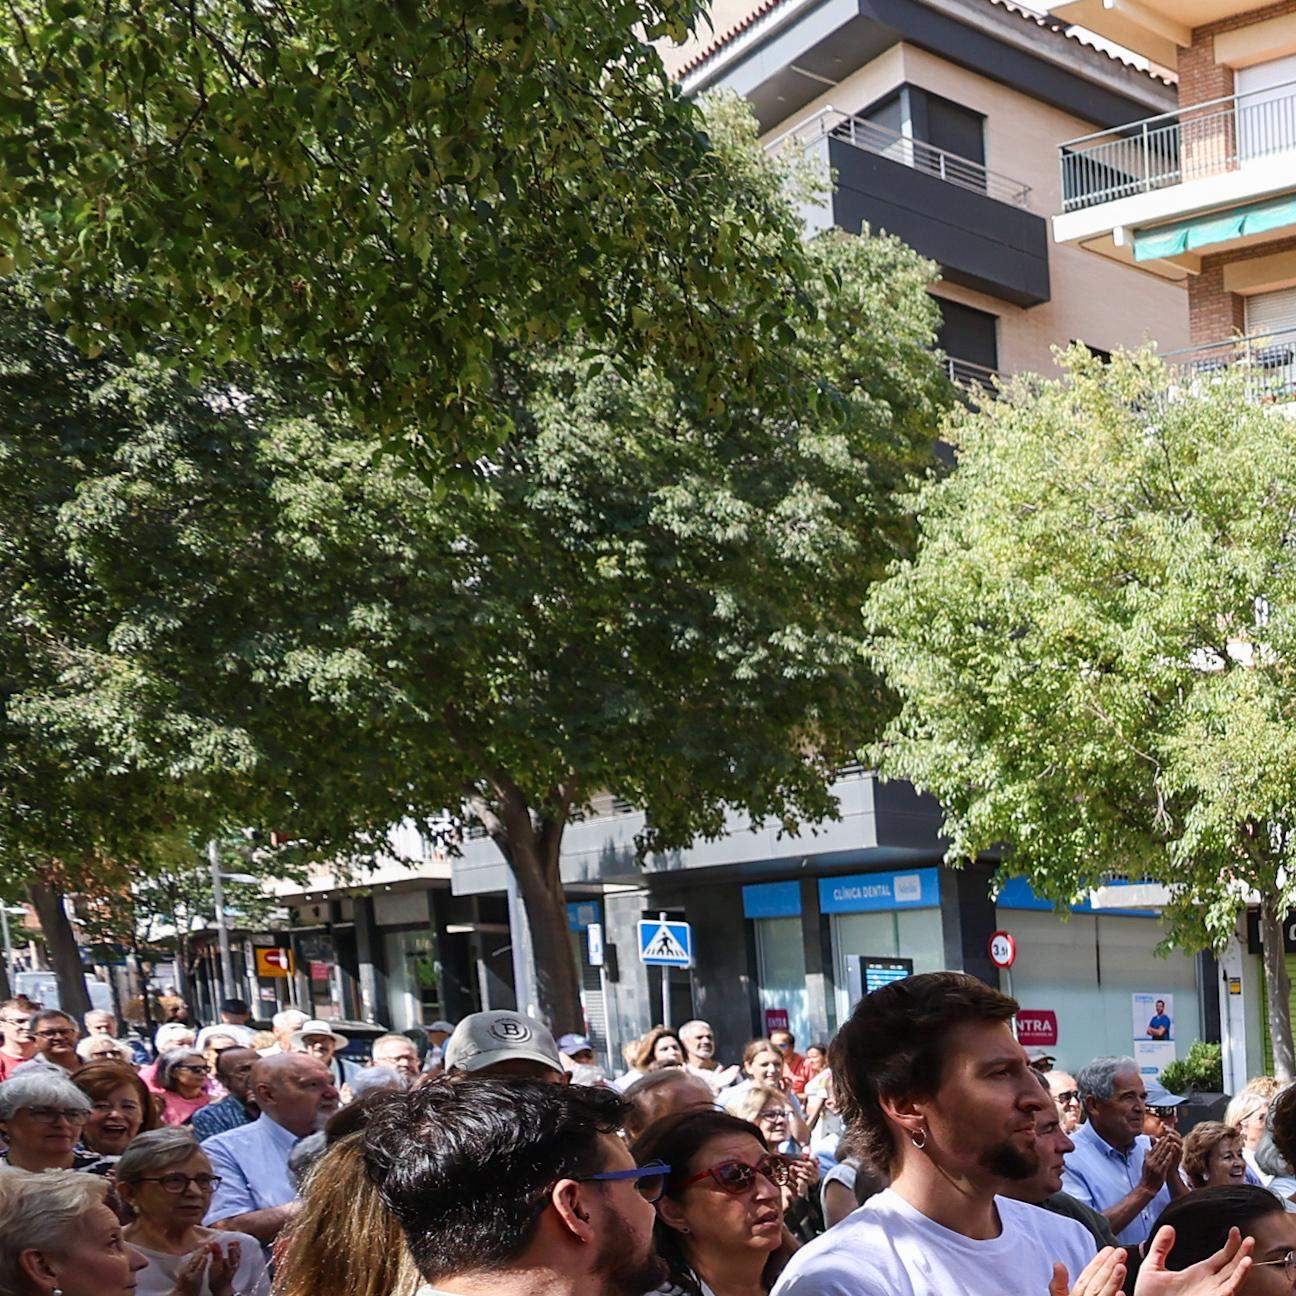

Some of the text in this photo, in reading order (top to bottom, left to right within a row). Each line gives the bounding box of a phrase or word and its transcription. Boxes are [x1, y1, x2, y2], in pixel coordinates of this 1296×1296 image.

[863, 883, 891, 898] DENTAL
[501, 1023, 520, 1036] B
[1017, 1019, 1053, 1032] NTRA
